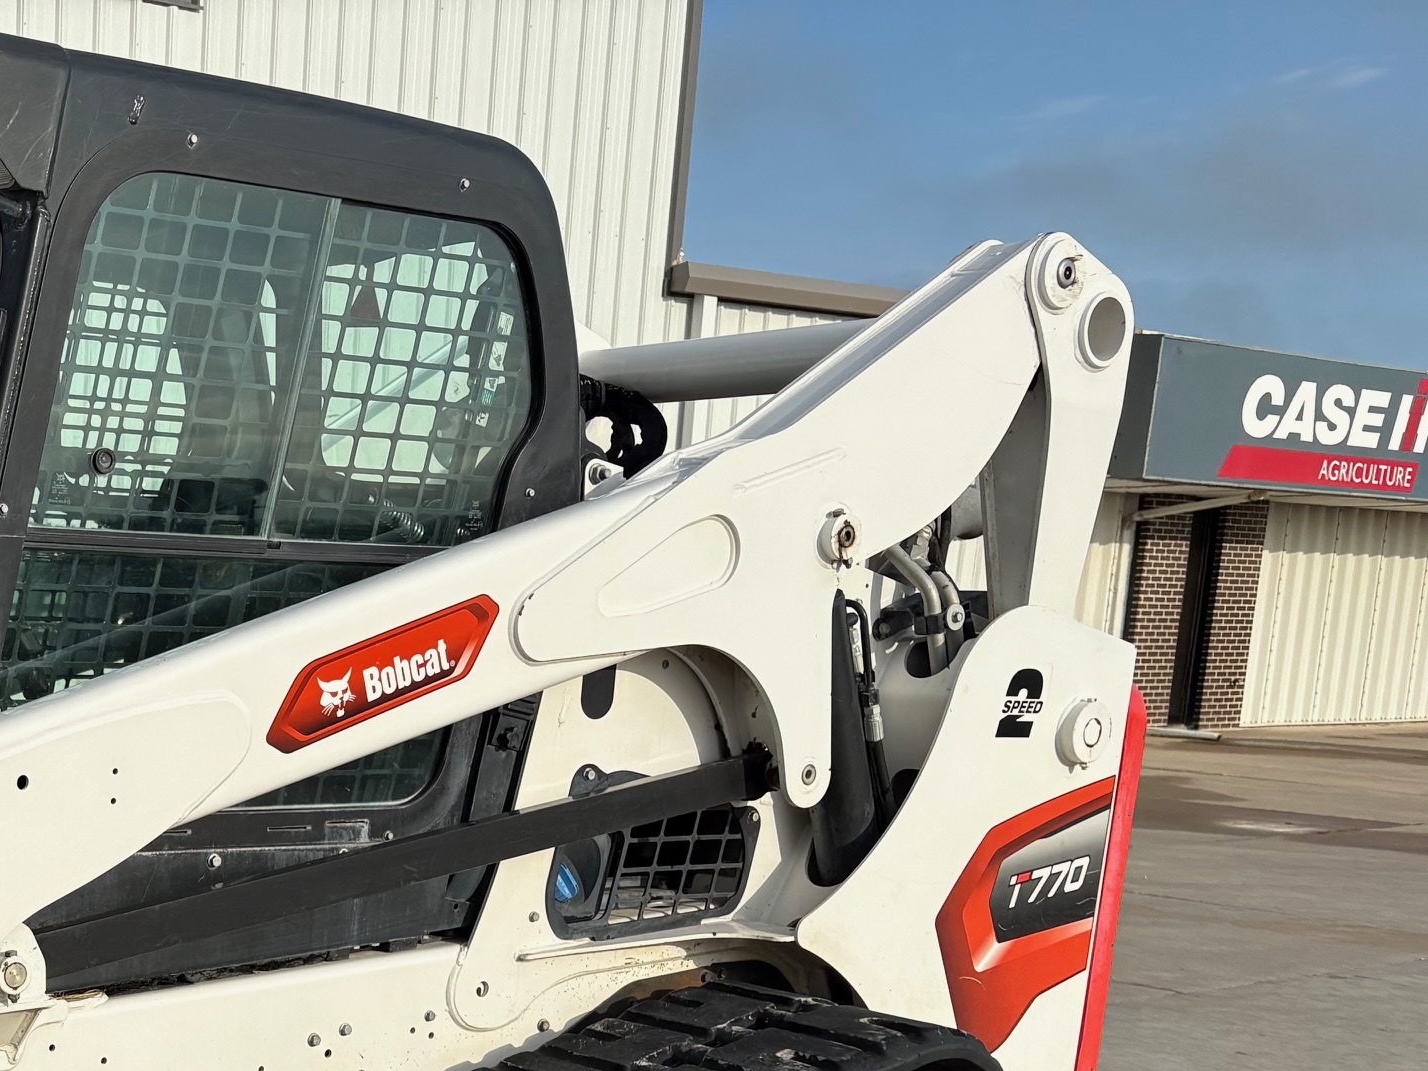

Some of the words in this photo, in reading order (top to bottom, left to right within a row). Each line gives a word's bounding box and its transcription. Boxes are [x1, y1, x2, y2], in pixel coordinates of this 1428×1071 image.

[1241, 374, 1392, 449] CASE
[1318, 458, 1414, 487] AGRICULTURE
[362, 638, 451, 703] Bobcat
[995, 668, 1044, 738] 2
[1001, 699, 1044, 714] SPEED
[1008, 854, 1091, 910] T770
